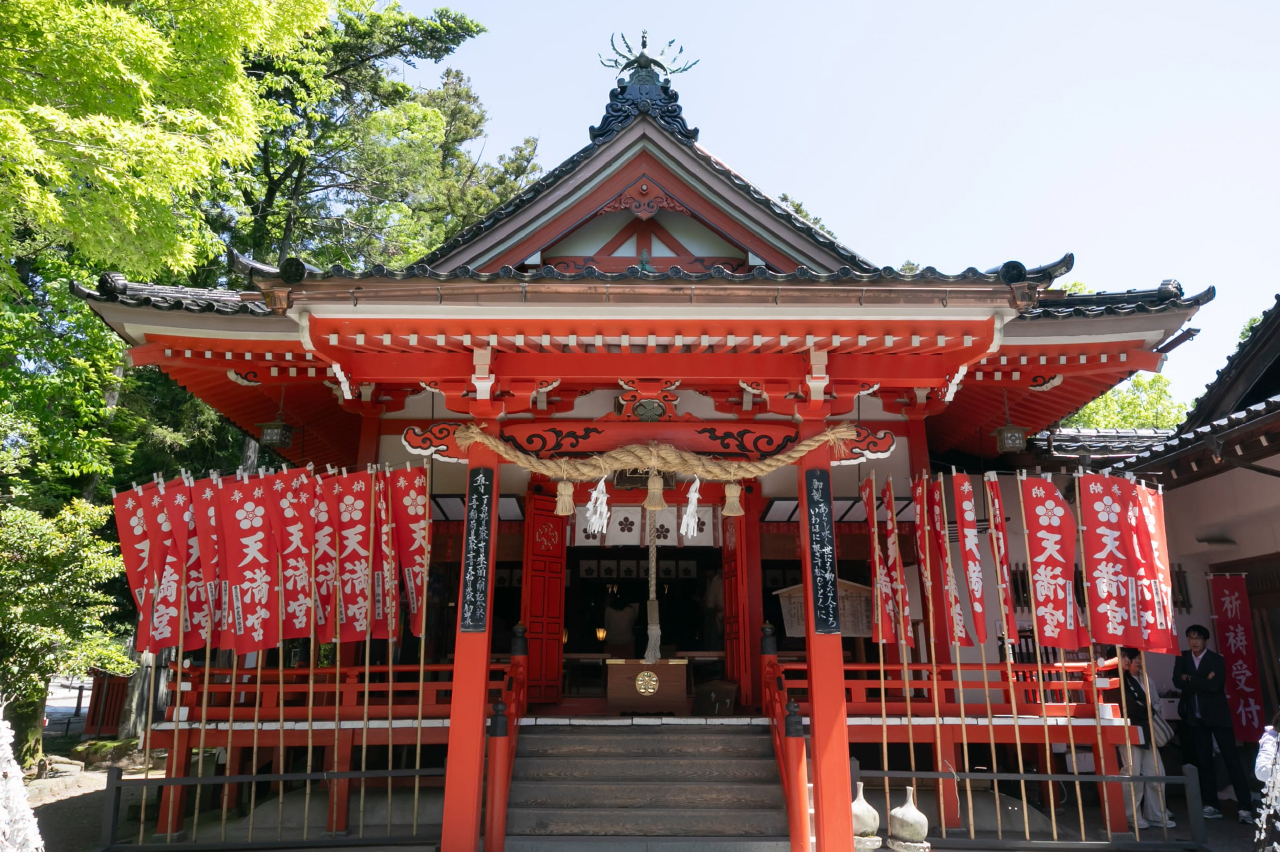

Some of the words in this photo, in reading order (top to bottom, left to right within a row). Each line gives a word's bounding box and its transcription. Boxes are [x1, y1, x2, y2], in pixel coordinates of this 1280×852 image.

[238, 531, 271, 642] 天満宮
[283, 521, 311, 629] 天満宮
[340, 524, 369, 632] 天満宮
[1221, 589, 1261, 729] 祈祷受付
